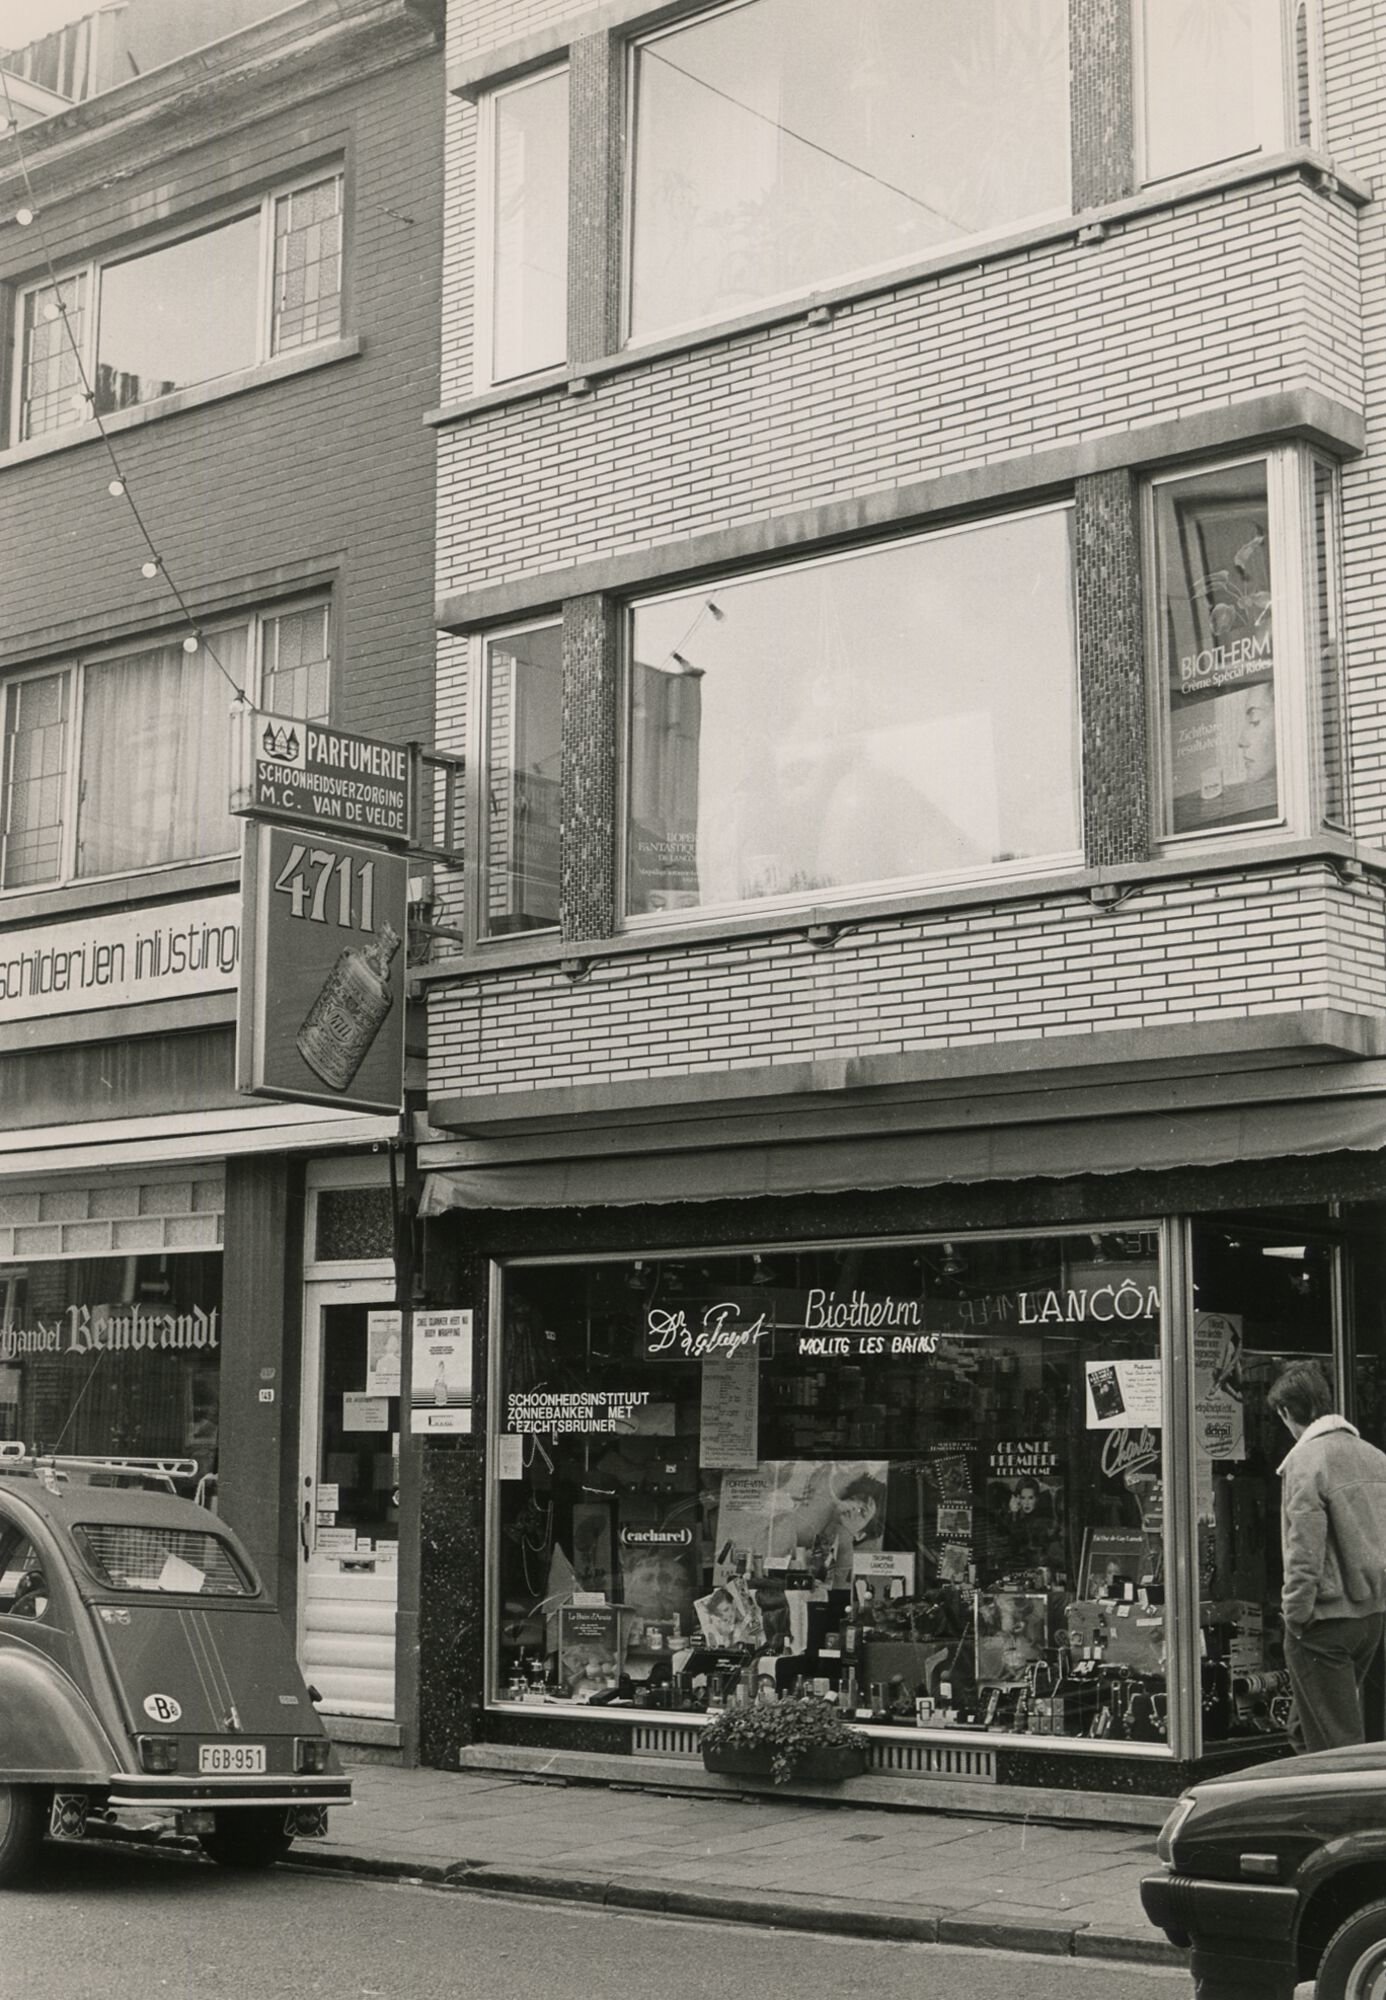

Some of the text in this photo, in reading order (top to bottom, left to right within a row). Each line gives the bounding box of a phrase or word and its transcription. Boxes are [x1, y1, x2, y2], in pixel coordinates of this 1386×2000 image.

[1181, 631, 1271, 681] BIOTHERM
[307, 734, 406, 781] PARFUMERIE
[258, 762, 404, 809] SCHOONHEIDSVERZORGING
[260, 785, 404, 830] M.C. VAN DE VELDE
[274, 843, 375, 933] 4711
[0, 921, 240, 1000] schilderijen inlijsting
[64, 1302, 220, 1355] Rembrandt
[804, 1288, 922, 1330] Biotherm
[799, 1335, 940, 1355] MOLITG LES BAINS
[507, 1392, 650, 1407] SCHOONHEIDSINSTITUUT
[507, 1405, 634, 1420] ZONNEBANKEN MET
[997, 1441, 1052, 1454] GRANDE
[1101, 1425, 1161, 1478] Charlie
[155, 1697, 171, 1720] B
